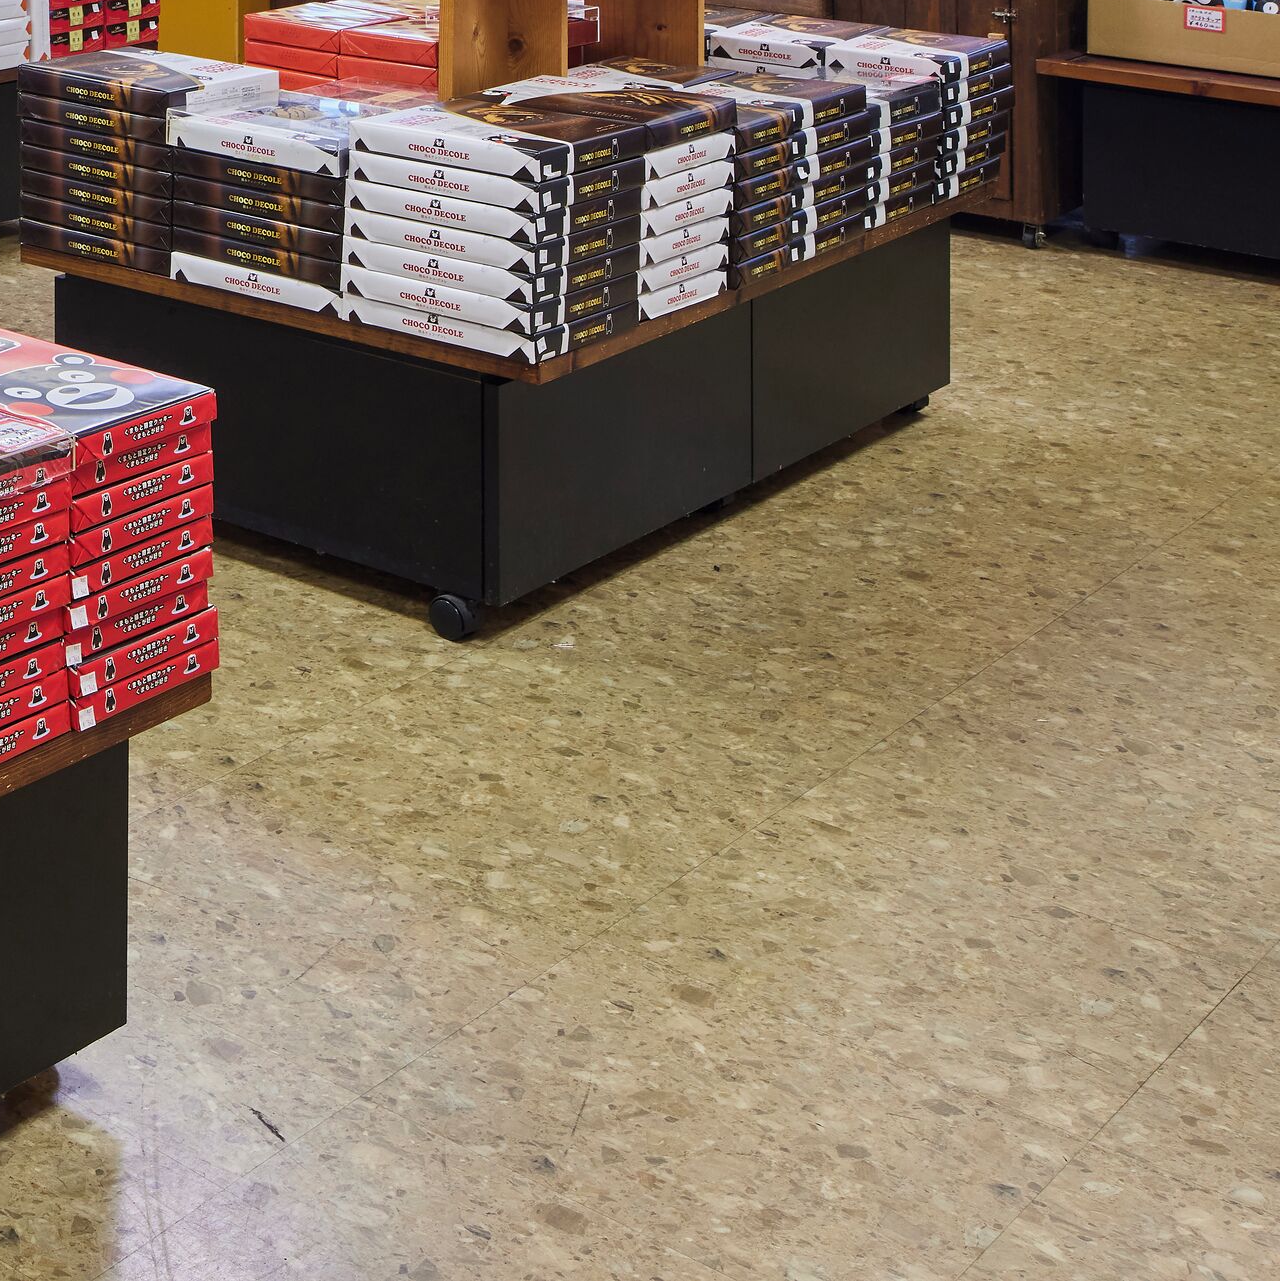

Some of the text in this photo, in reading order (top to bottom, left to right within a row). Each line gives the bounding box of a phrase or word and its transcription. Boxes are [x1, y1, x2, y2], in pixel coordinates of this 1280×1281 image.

[856, 61, 914, 75] CHOCO DECOLE
[66, 85, 115, 102] CHOCO DECOLE
[221, 140, 275, 157] CHOCO DECOLE
[408, 142, 469, 161] CHOCO DECOLE
[579, 148, 611, 162] CHOCO DECOLE
[677, 149, 706, 165] CHOCO DECOLE
[402, 317, 464, 339] CHOCO DECOLE
